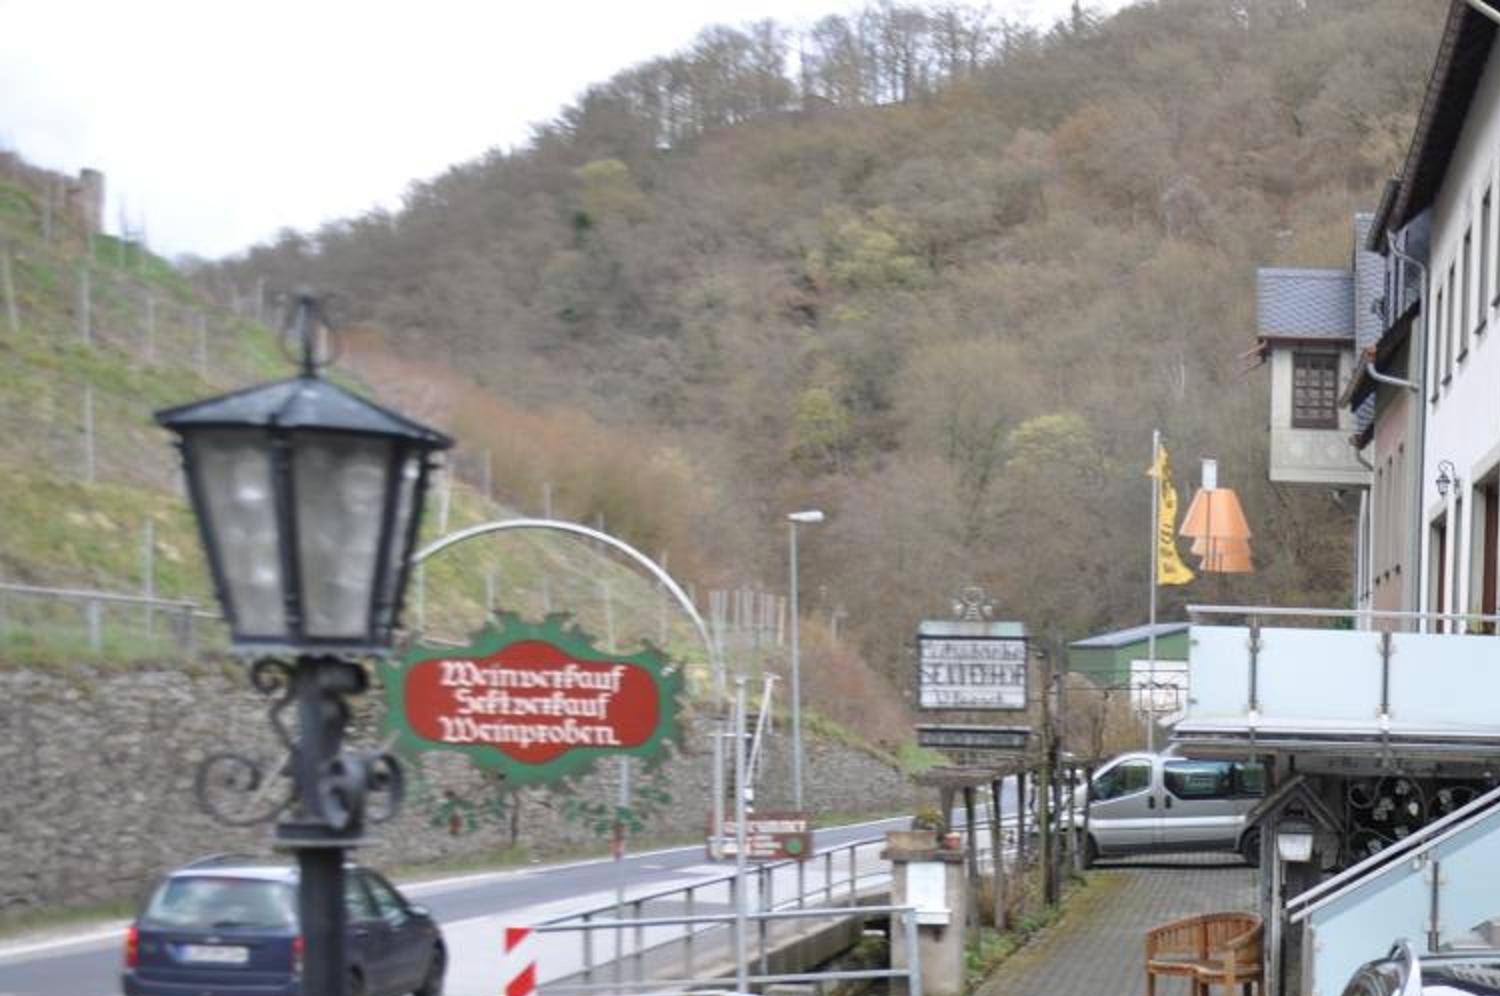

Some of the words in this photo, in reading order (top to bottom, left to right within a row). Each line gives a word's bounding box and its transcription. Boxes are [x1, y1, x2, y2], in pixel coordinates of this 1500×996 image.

[440, 660, 625, 692] Weinverkauf
[454, 688, 610, 719] Sektverkauf
[438, 717, 620, 748] Weinproben
